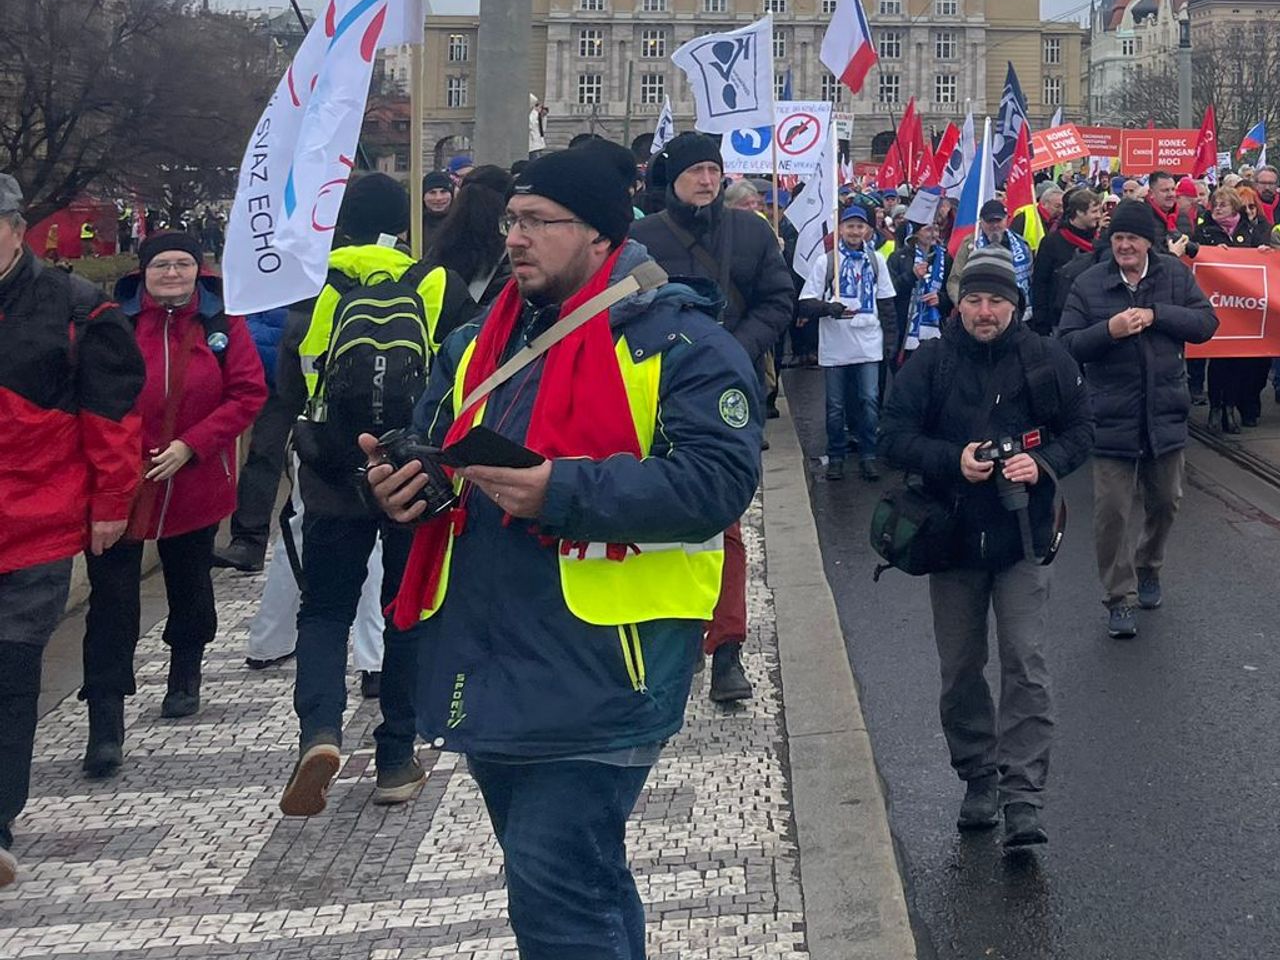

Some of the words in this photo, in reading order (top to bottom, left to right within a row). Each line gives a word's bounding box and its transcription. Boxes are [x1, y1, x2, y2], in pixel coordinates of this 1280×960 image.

[249, 117, 271, 187] SVAZ
[1158, 139, 1187, 147] KONEC
[248, 195, 282, 274] ECHO
[1209, 291, 1267, 311] ČMKOS
[372, 355, 387, 425] HEAD
